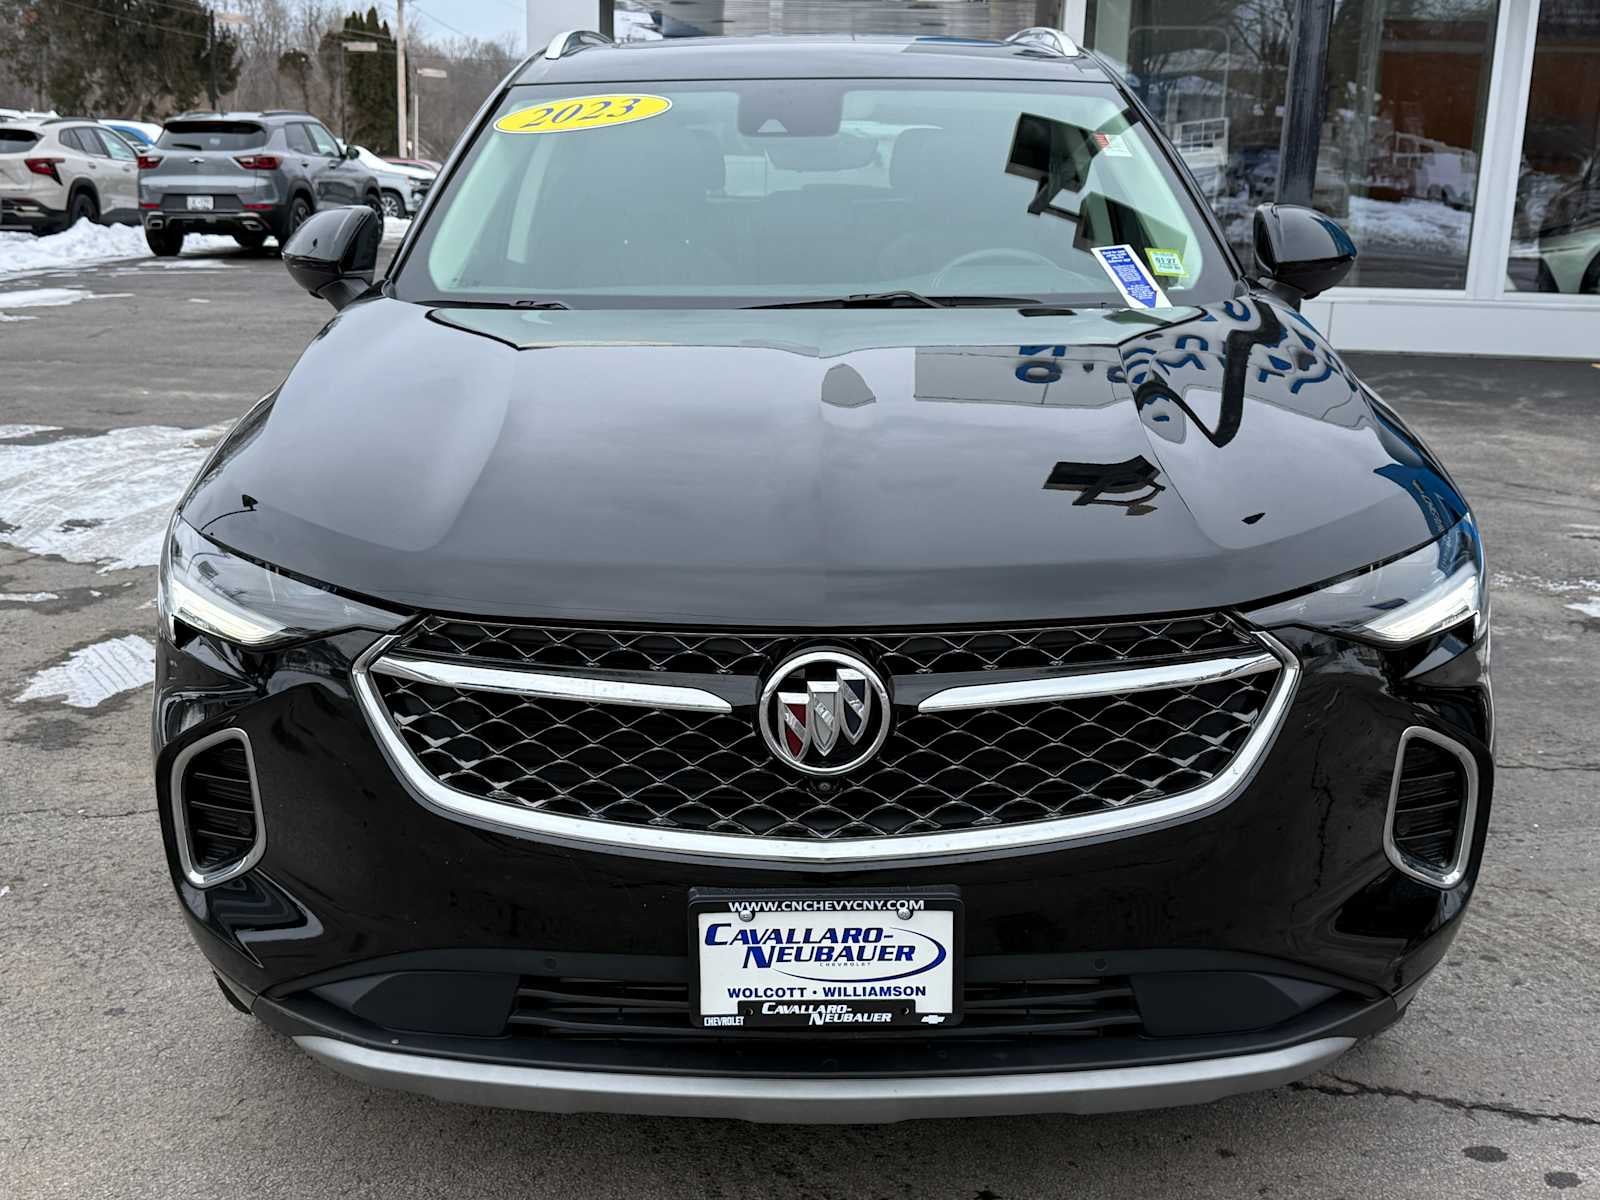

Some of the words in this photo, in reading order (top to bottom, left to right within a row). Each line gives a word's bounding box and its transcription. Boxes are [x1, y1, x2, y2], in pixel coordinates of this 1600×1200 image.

[520, 98, 640, 128] 2023
[728, 899, 925, 912] WWW.CNCHEVYCNY.COM
[704, 923, 894, 946] CAVALLARO-
[742, 945, 916, 969] NEUBAUER
[727, 987, 807, 999] WOLCOTT
[823, 986, 927, 998] WILLIAMSON
[762, 1002, 853, 1015] CAVALLARO-
[704, 1015, 745, 1027] CHEVROLET
[808, 1011, 892, 1026] NEUBAUER
